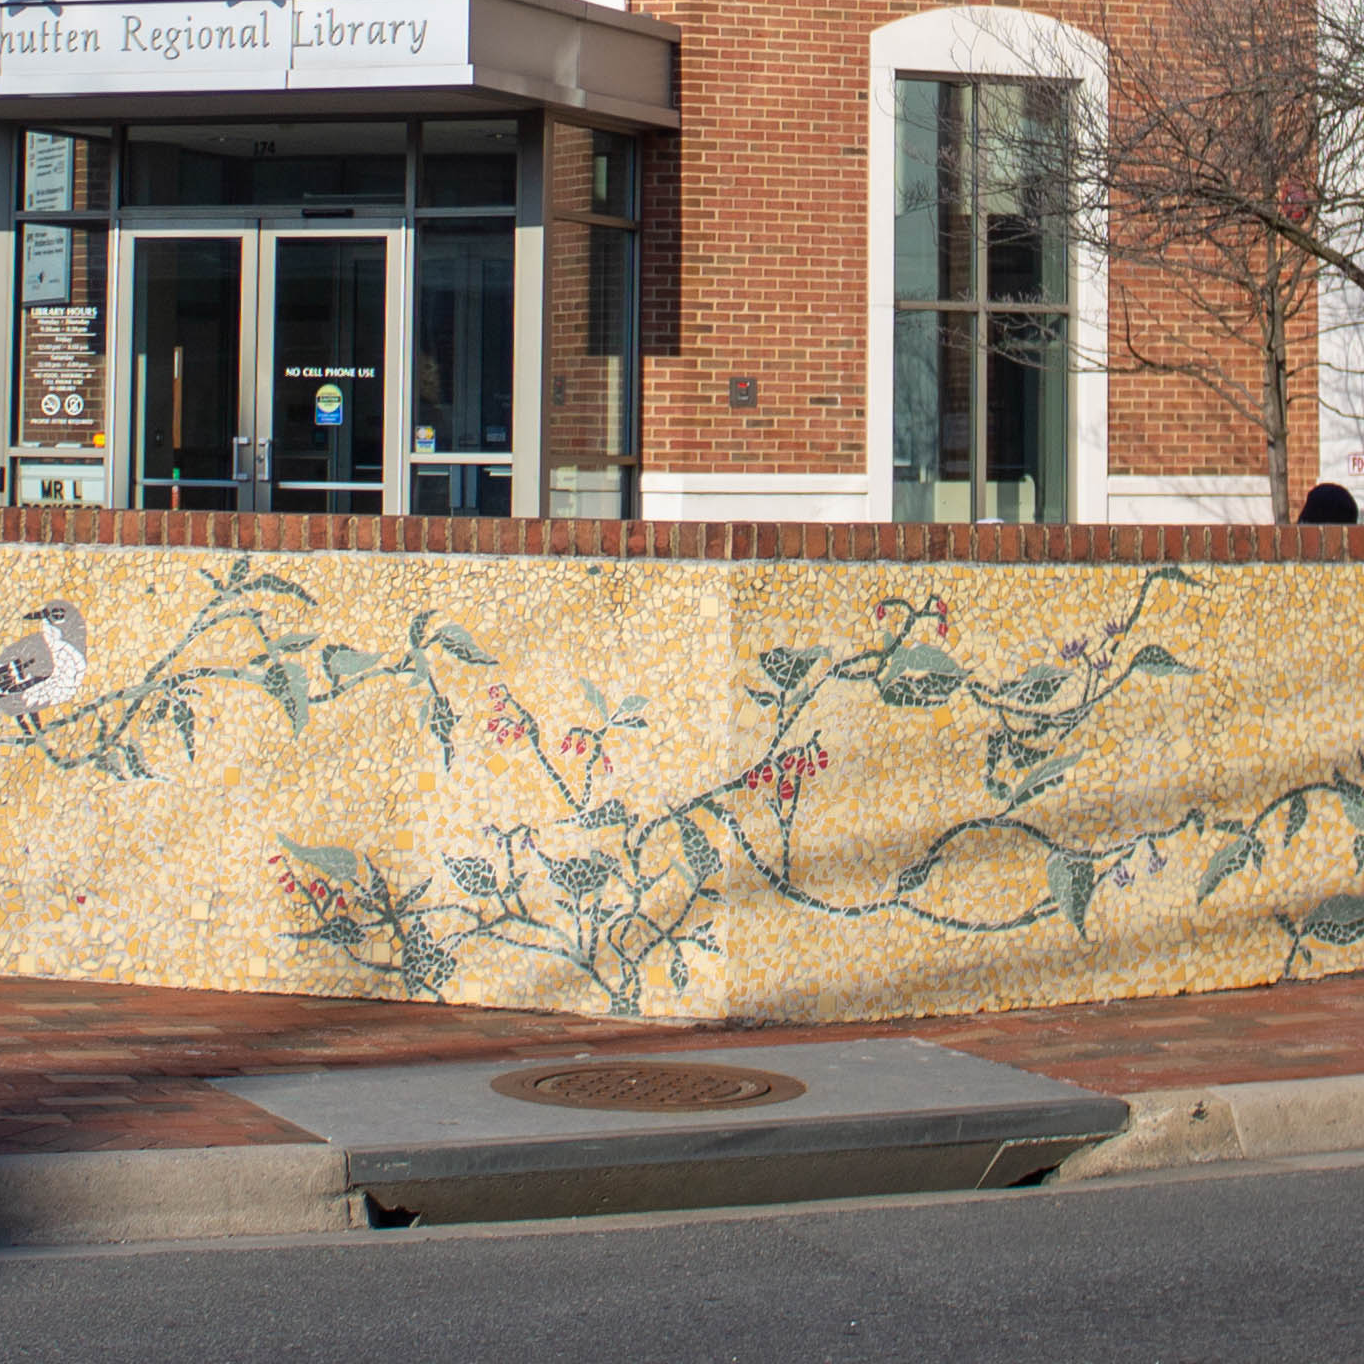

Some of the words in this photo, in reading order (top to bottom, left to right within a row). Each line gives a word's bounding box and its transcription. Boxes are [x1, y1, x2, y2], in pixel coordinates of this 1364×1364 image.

[120, 11, 271, 60] Regional
[291, 11, 428, 54] Library
[31, 307, 65, 316] LIBRARY
[67, 307, 97, 316] HOURS
[285, 367, 301, 377] NO
[302, 367, 323, 377] CELL
[325, 367, 356, 377] PHONE
[358, 367, 375, 378] USE
[41, 480, 64, 499] MR
[73, 480, 82, 499] L
